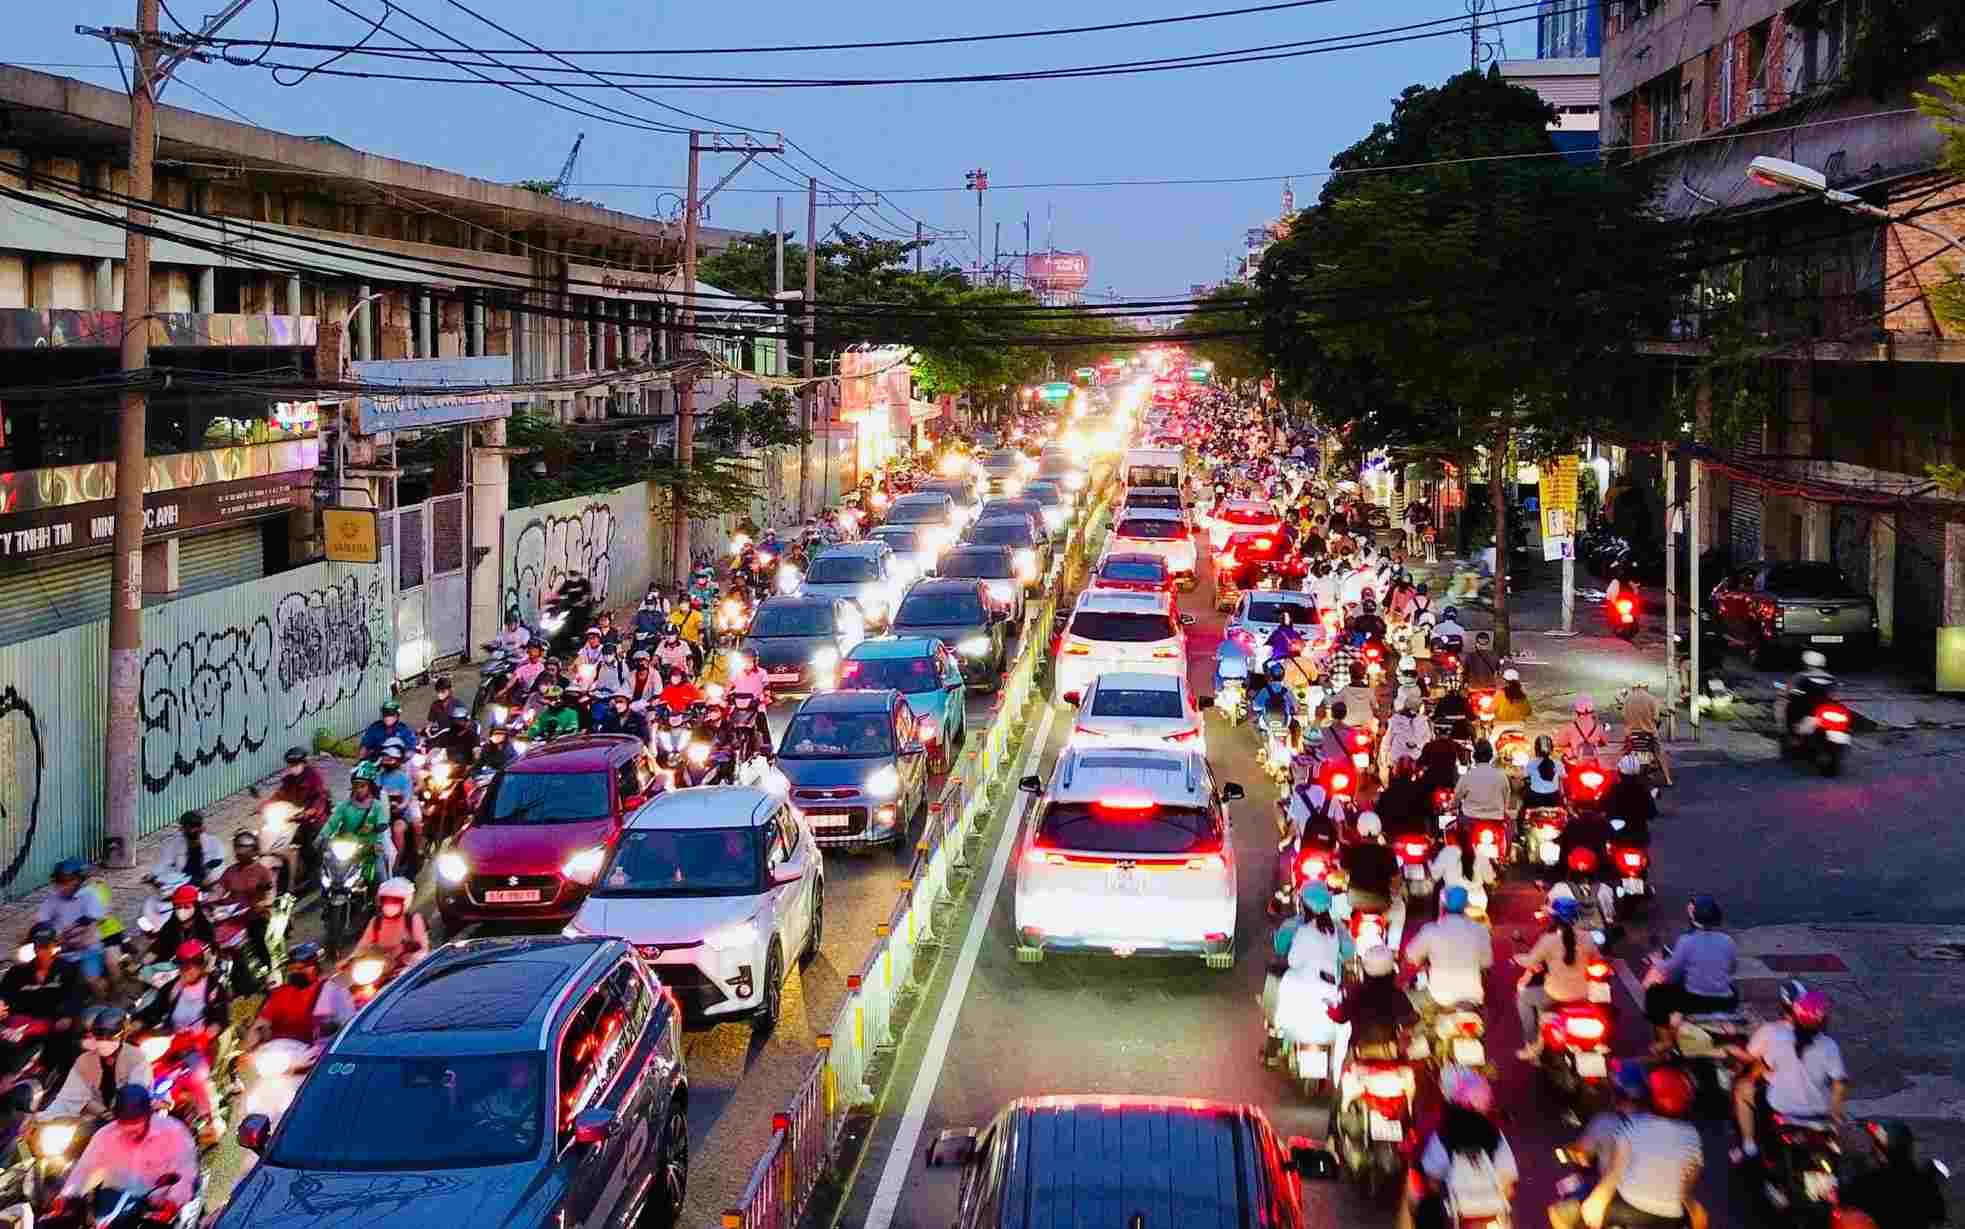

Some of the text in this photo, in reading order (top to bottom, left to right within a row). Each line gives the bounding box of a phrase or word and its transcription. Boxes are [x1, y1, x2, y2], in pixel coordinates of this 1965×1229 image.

[14, 526, 51, 553] TNHH
[52, 522, 73, 545] TM
[156, 503, 179, 527] ANH
